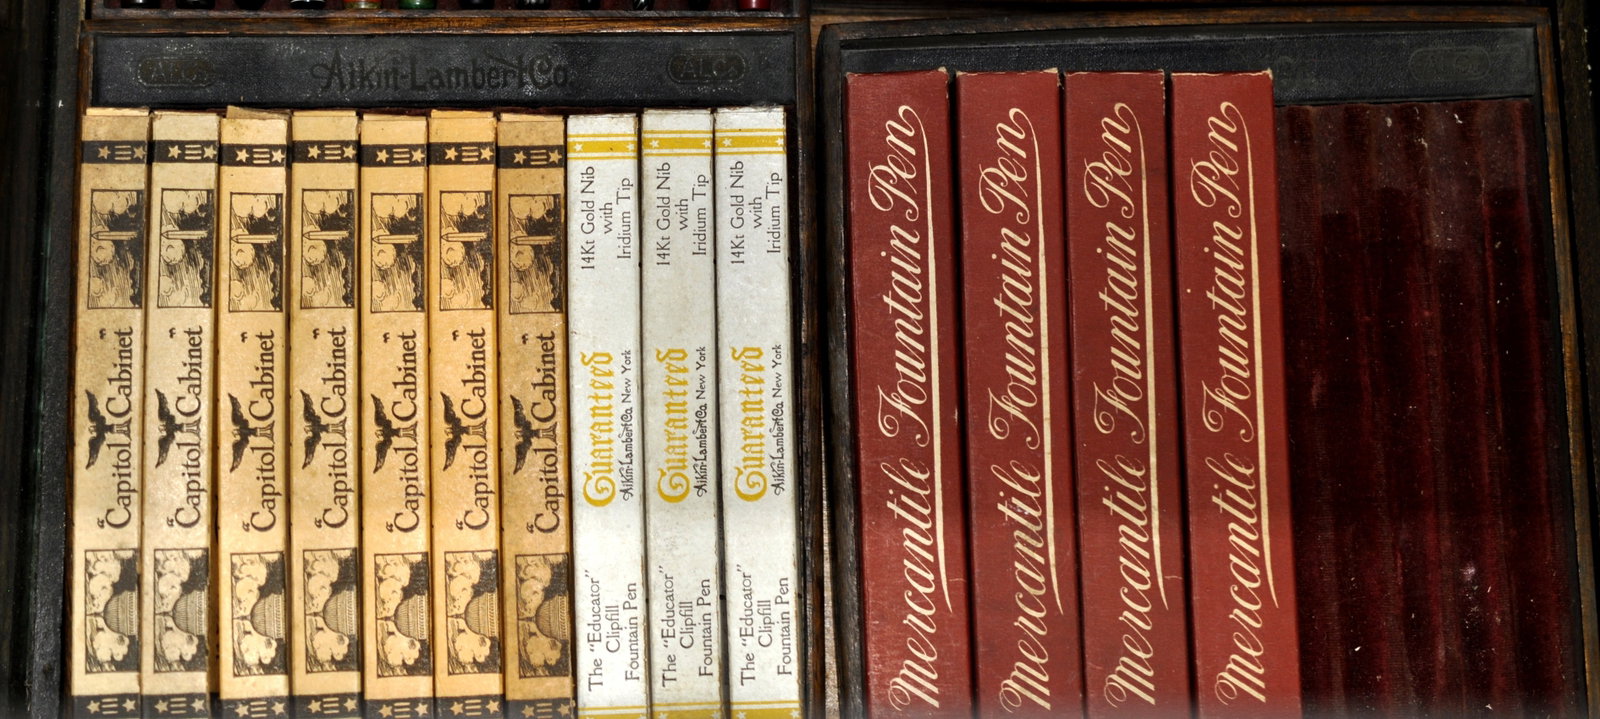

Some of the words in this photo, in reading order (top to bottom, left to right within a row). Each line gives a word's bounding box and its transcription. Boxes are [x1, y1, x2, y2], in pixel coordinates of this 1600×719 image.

[657, 162, 671, 190] Nib
[730, 160, 744, 189] Nib
[868, 105, 925, 222] Pen
[979, 108, 1034, 225] Pen
[1083, 102, 1138, 219] Pen
[1191, 101, 1245, 218] Pen
[581, 166, 595, 194] Nib
[616, 177, 634, 205] Tip
[692, 174, 709, 201] Tip
[766, 172, 782, 199] Tip
[581, 200, 595, 234] Gold
[599, 202, 613, 234] with
[657, 196, 671, 230] Gold
[675, 198, 688, 230] with
[731, 195, 744, 229] Gold
[749, 196, 762, 228] with
[617, 211, 631, 259] Iridium
[692, 207, 706, 256] Iridium
[767, 205, 781, 254] Iridium
[581, 240, 595, 269] 14Kt
[657, 236, 671, 265] 14Kt
[731, 234, 744, 264] 14Kt
[878, 224, 929, 448] Fountain
[988, 227, 1040, 450] Fountain
[1093, 217, 1146, 445] Fountain
[1202, 215, 1255, 442] Fountain
[621, 349, 631, 374] York
[696, 346, 706, 371] York
[772, 344, 782, 368] York
[621, 379, 631, 403] New
[696, 375, 706, 399] New
[772, 373, 782, 397] New
[580, 352, 616, 507] Guaranteed
[656, 348, 691, 503] Guaranteed
[731, 346, 768, 502] Guaranteed
[696, 578, 712, 606] Pen
[775, 577, 790, 605] Pen
[880, 458, 939, 711] Mercantile
[991, 460, 1050, 713] Mercantile
[1096, 453, 1155, 708] Mercantile
[1205, 452, 1266, 705] Mercantile
[623, 582, 638, 611] Pen
[605, 605, 623, 653] Clipfill
[679, 601, 696, 649] Clipfill
[757, 599, 775, 648] Clipfill
[625, 616, 640, 681] Fountain
[698, 612, 713, 677] Fountain
[777, 610, 792, 676] Fountain
[588, 658, 603, 692] The
[662, 654, 677, 688] The
[740, 652, 756, 686] The
